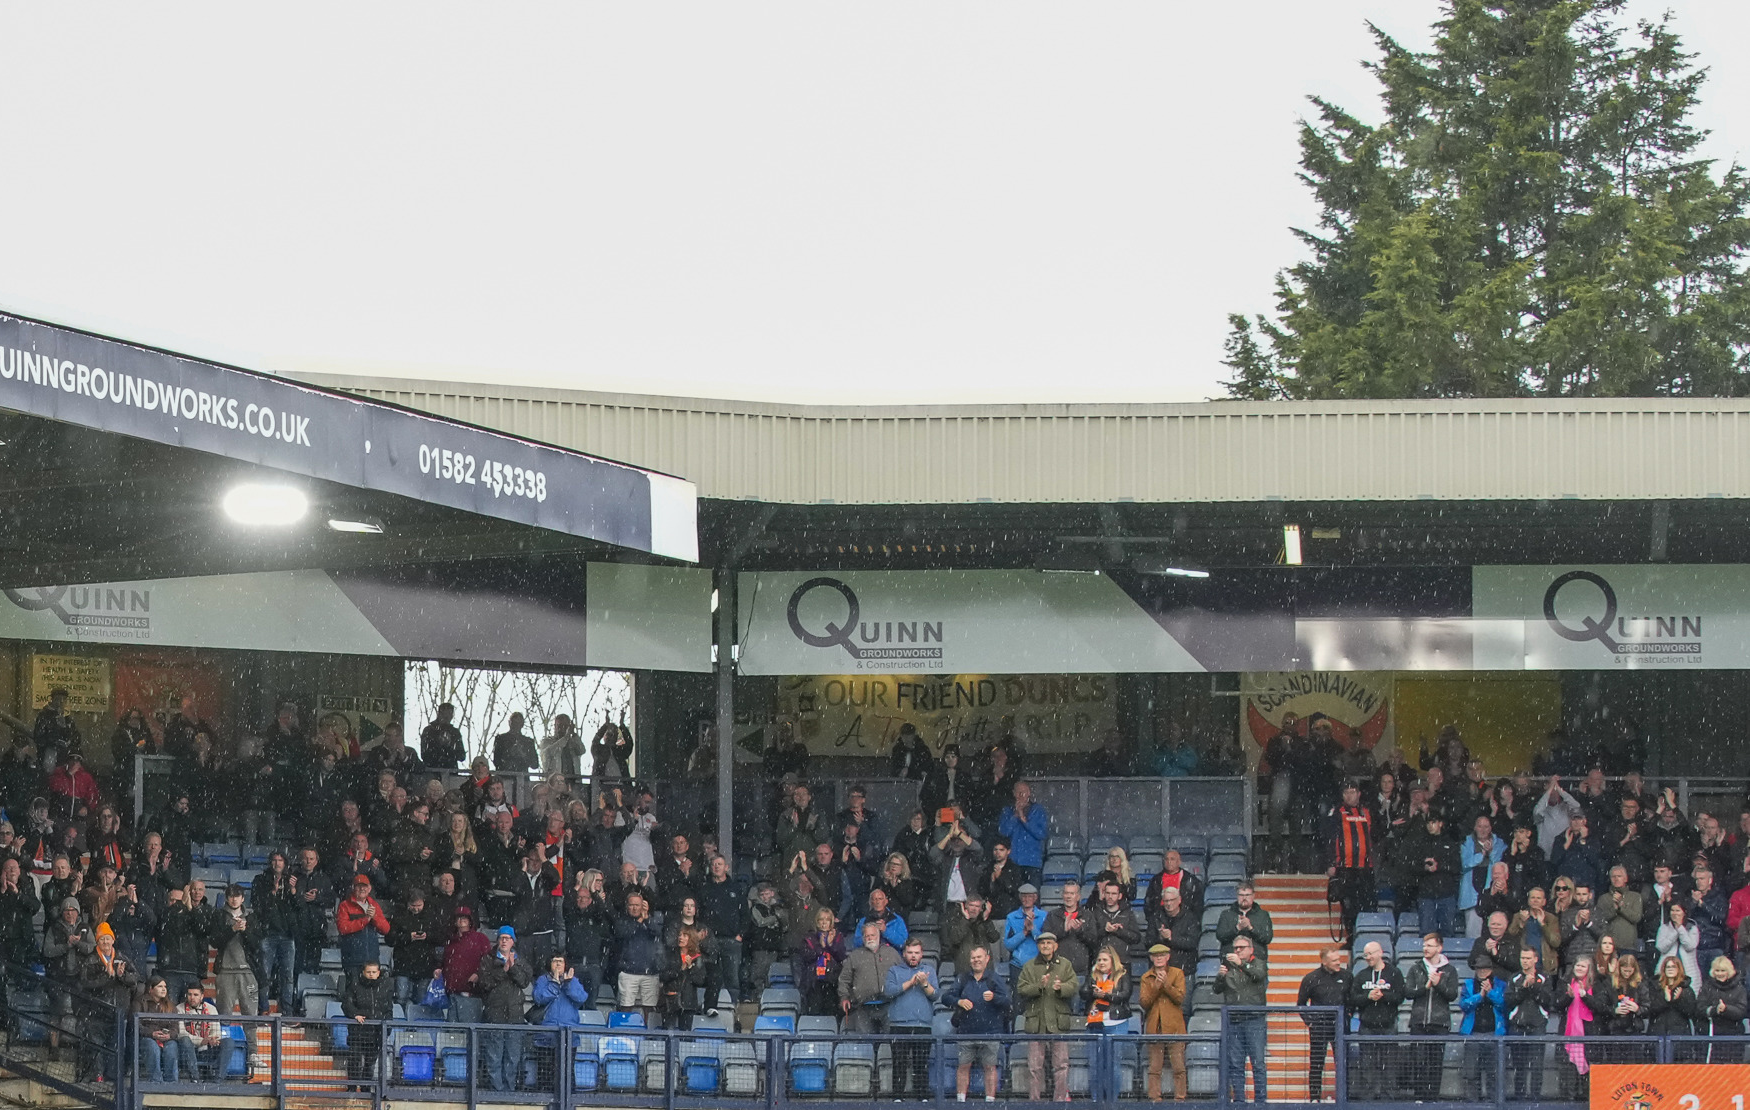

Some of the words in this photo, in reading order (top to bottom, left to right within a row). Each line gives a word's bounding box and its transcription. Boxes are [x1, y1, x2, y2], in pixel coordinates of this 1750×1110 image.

[418, 443, 476, 485] 01582
[481, 458, 548, 503] 453338
[1543, 571, 1702, 641] QUINN
[787, 577, 943, 648] QUINN
[69, 616, 148, 627] GROUNDWORKS
[66, 628, 72, 636] &
[76, 628, 133, 638] Construction
[136, 630, 150, 639] Ltd
[860, 649, 941, 658] GROUNDWORKS
[1618, 644, 1700, 653] GROUNDWORKS
[856, 661, 863, 669] &
[866, 661, 926, 669] Construction
[929, 660, 943, 669] Ltd
[1614, 655, 1621, 664] &
[1687, 655, 1702, 664] Ltd
[824, 680, 887, 707] OUR
[896, 678, 997, 710] FRIEND
[1258, 673, 1378, 714] SCANDINAVIAN
[85, 697, 107, 705] ZONE
[1612, 1082, 1638, 1101] LUTON
[1641, 1082, 1664, 1101] TOWN
